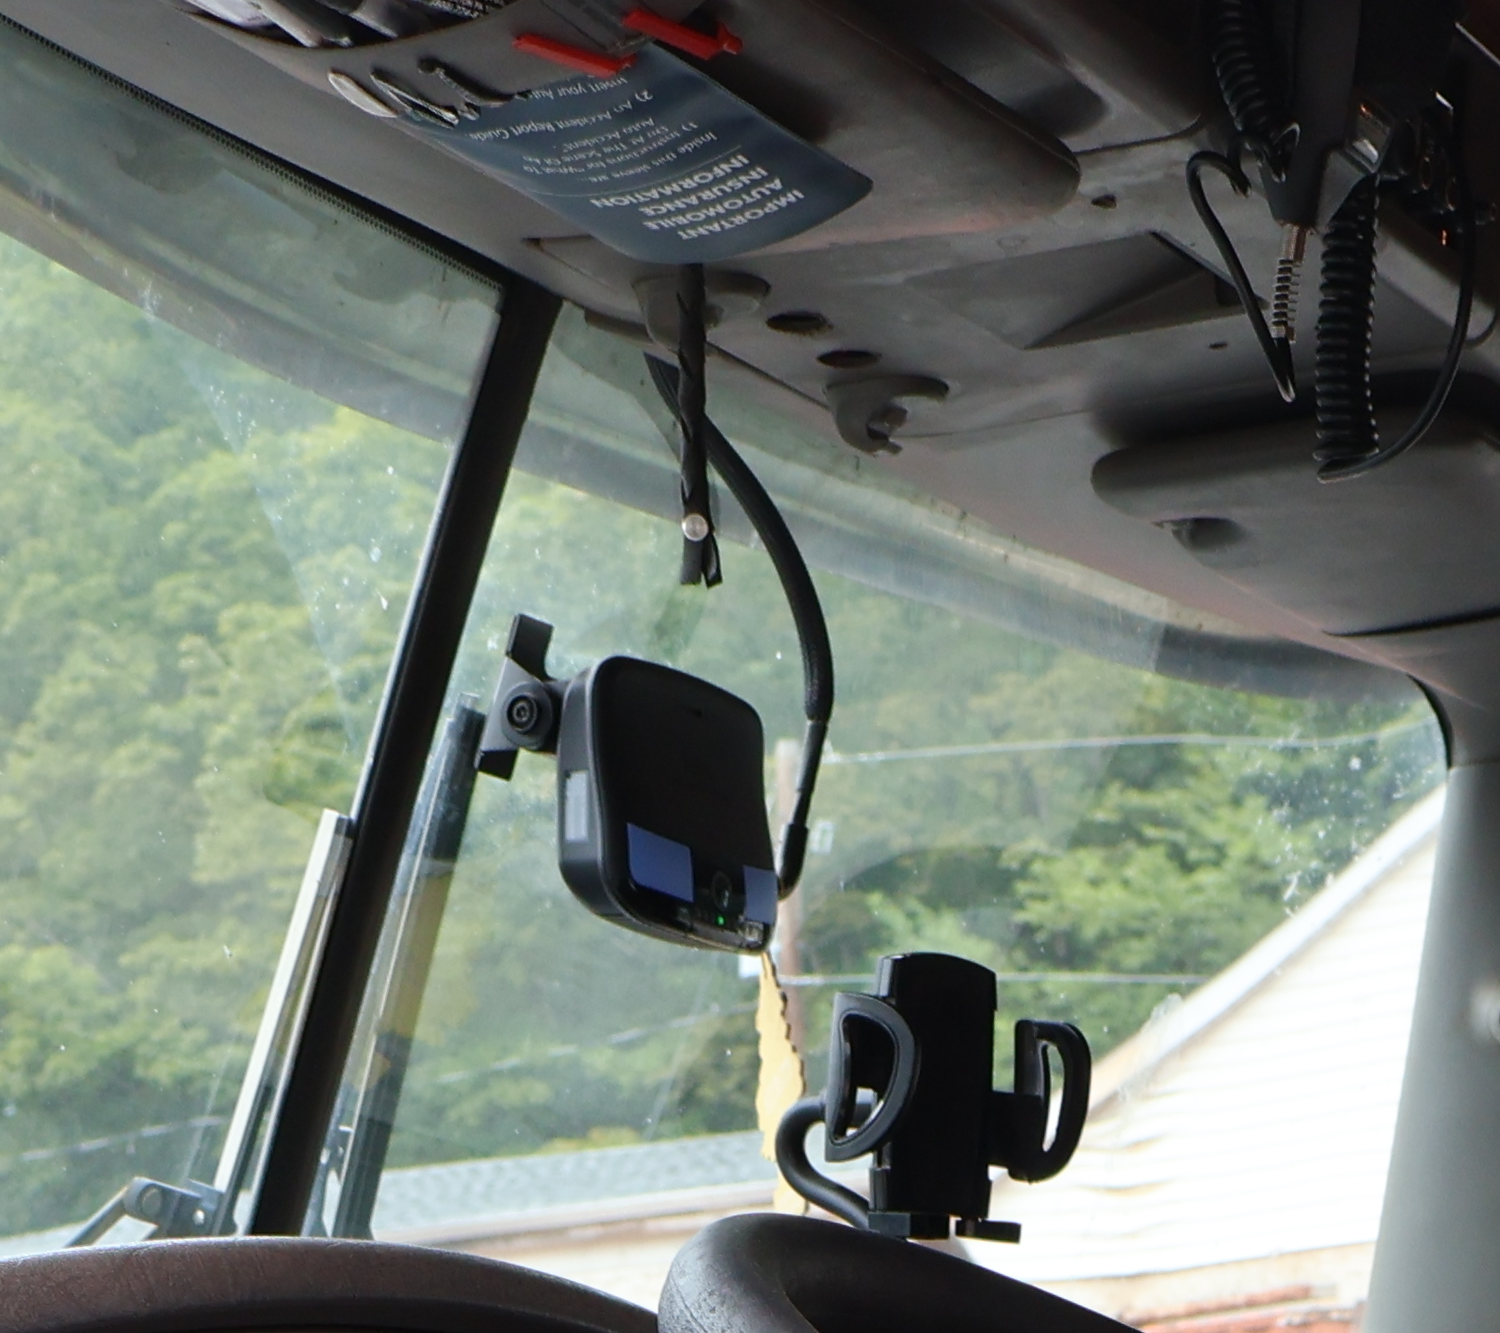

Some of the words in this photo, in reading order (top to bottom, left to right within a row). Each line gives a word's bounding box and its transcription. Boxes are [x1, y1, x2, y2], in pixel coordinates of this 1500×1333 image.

[557, 83, 588, 97] your
[633, 89, 654, 103] 2)
[612, 99, 634, 114] An
[508, 119, 556, 138] Report
[556, 110, 612, 131] Accident
[622, 117, 656, 135] Auto
[602, 141, 628, 156] The
[676, 131, 718, 155] Inside
[651, 150, 677, 169] this
[589, 154, 750, 209] INFORMATION
[638, 166, 769, 217] INSURANCE
[642, 178, 783, 230] AUTOMOBILE
[678, 189, 804, 240] IMPORTANT
